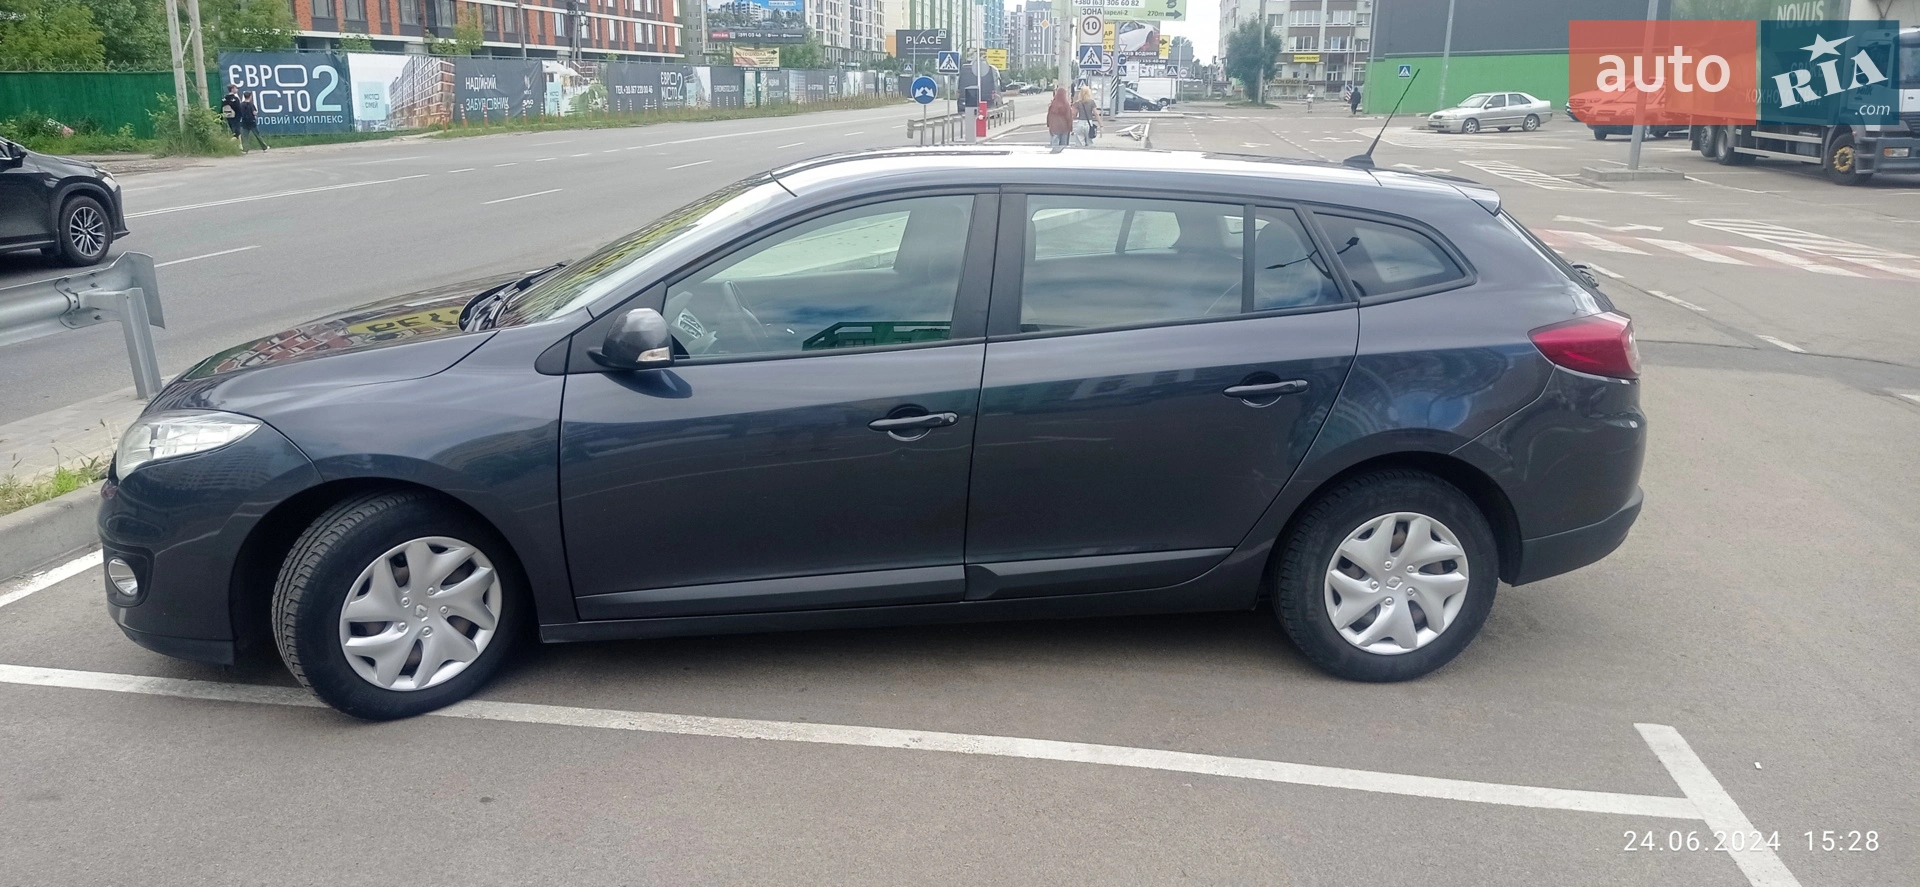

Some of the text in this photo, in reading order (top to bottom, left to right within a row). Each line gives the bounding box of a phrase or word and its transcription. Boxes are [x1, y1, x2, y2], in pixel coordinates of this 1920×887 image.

[1776, 1, 1825, 29] NOVUS
[1086, 21, 1098, 30] 10
[905, 36, 942, 45] PLACE
[228, 64, 308, 87] ЄВРО
[465, 74, 497, 92] НАДІЙНИЙ
[312, 65, 342, 112] 2
[240, 90, 311, 113] ІСТО
[293, 115, 343, 124] КОМПЛЕКС
